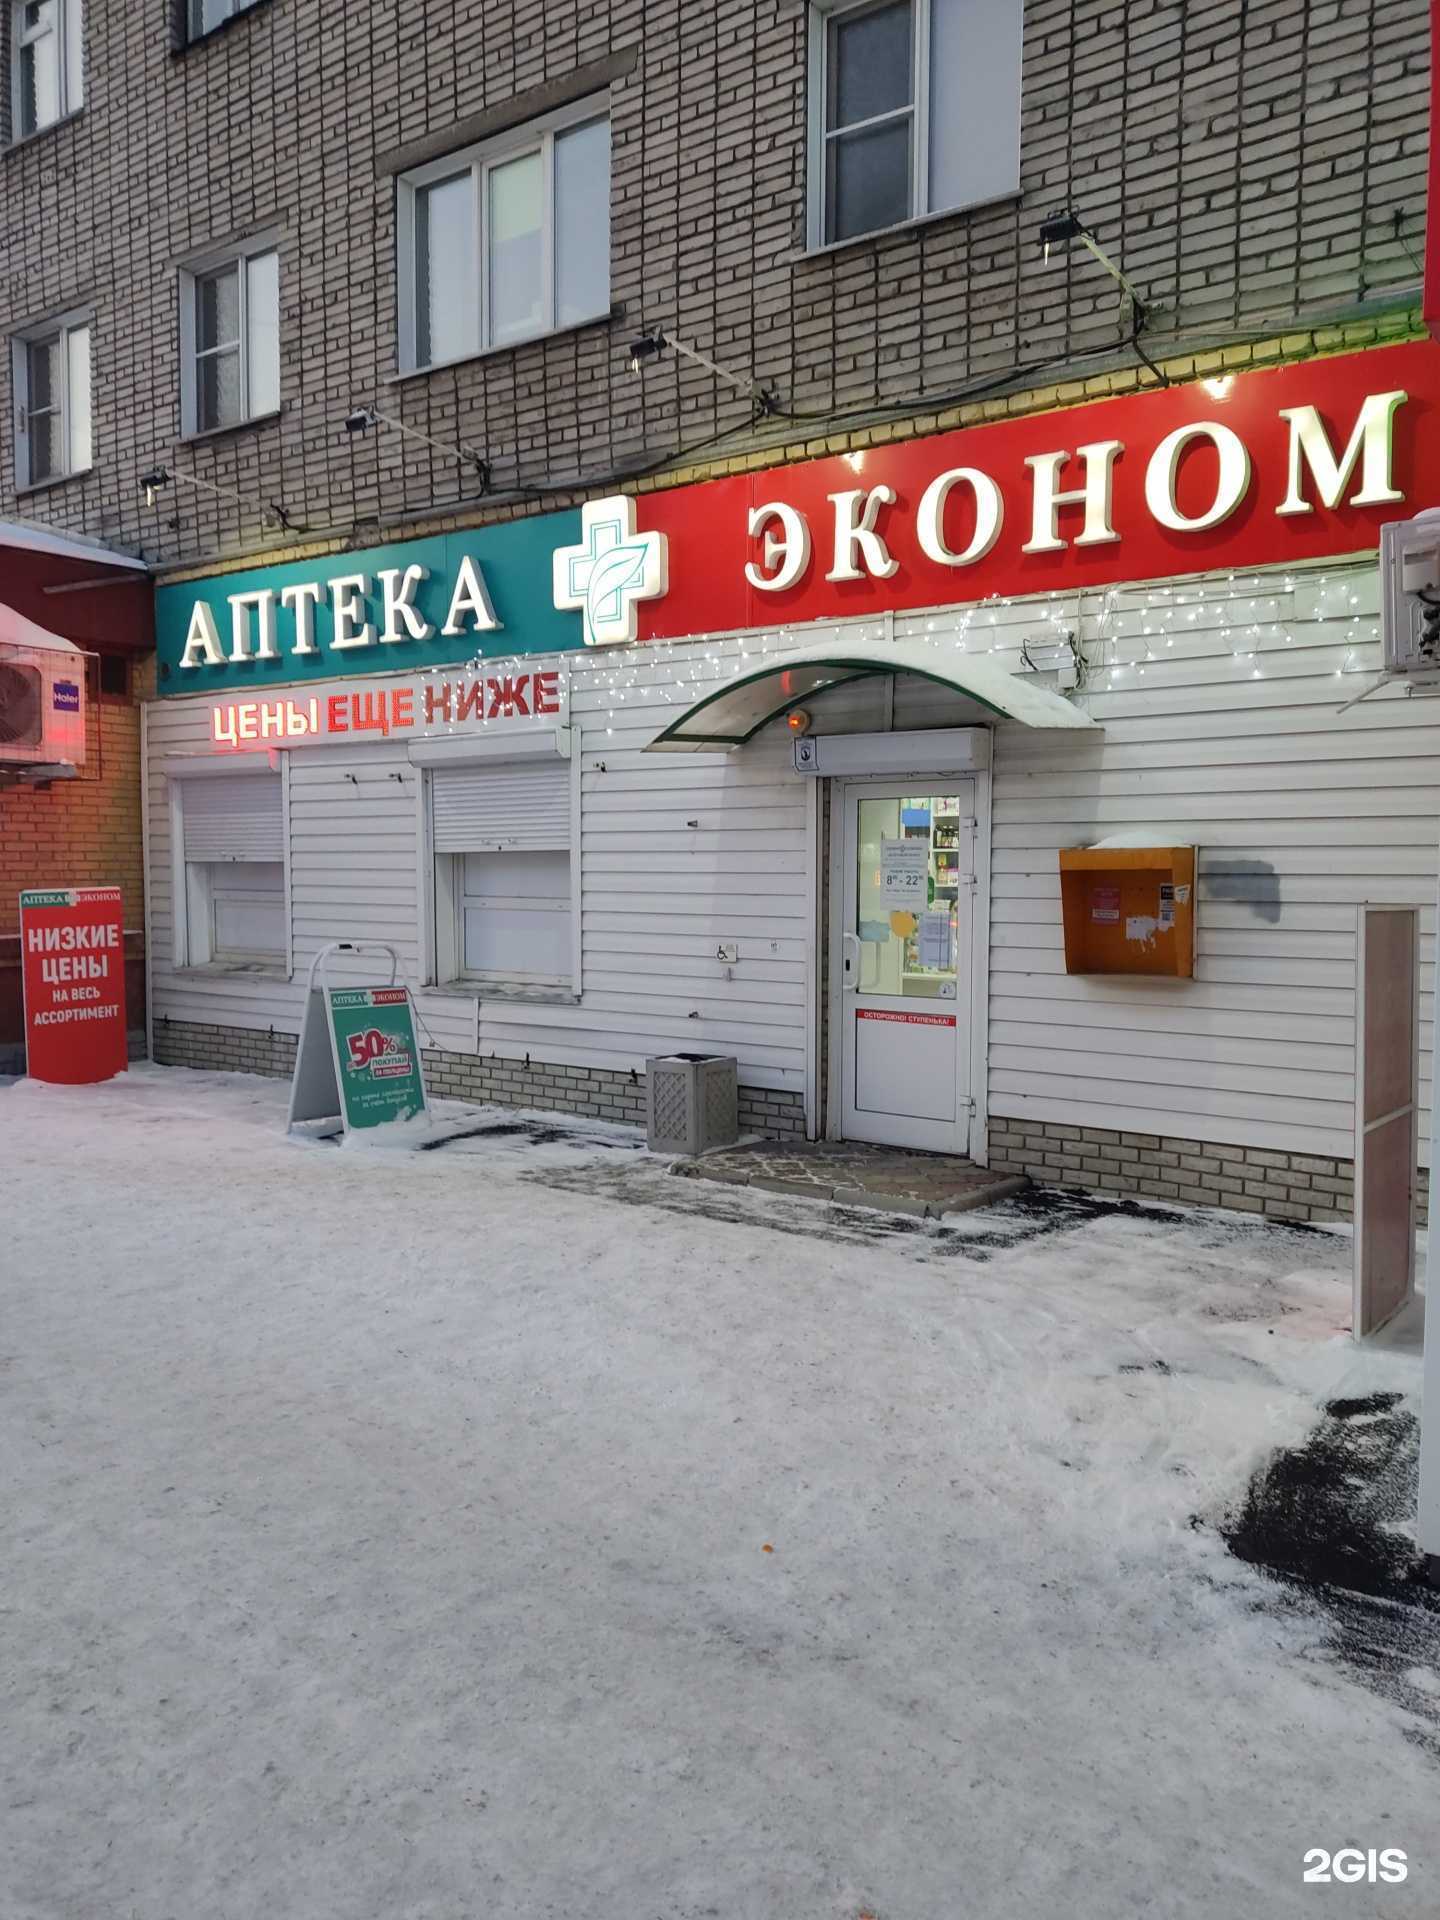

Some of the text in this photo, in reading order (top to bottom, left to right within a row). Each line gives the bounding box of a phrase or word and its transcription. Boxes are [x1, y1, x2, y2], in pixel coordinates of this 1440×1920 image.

[179, 389, 1409, 668] АПТЕКА ЭКОНОМ
[213, 671, 561, 748] ЦЕНЫ ЕЩЕ НИЖЕ
[23, 894, 64, 905] АПТЕКА
[28, 924, 119, 952] НИЗКИЕ
[42, 955, 108, 985] ЦЕНЫ
[53, 986, 101, 1003] НА ВЕСЬ
[34, 1004, 119, 1025] АССОРТИМЕНТ
[863, 1011, 949, 1025] ОСТОРОЖНО! СТУПЕНЬКА!
